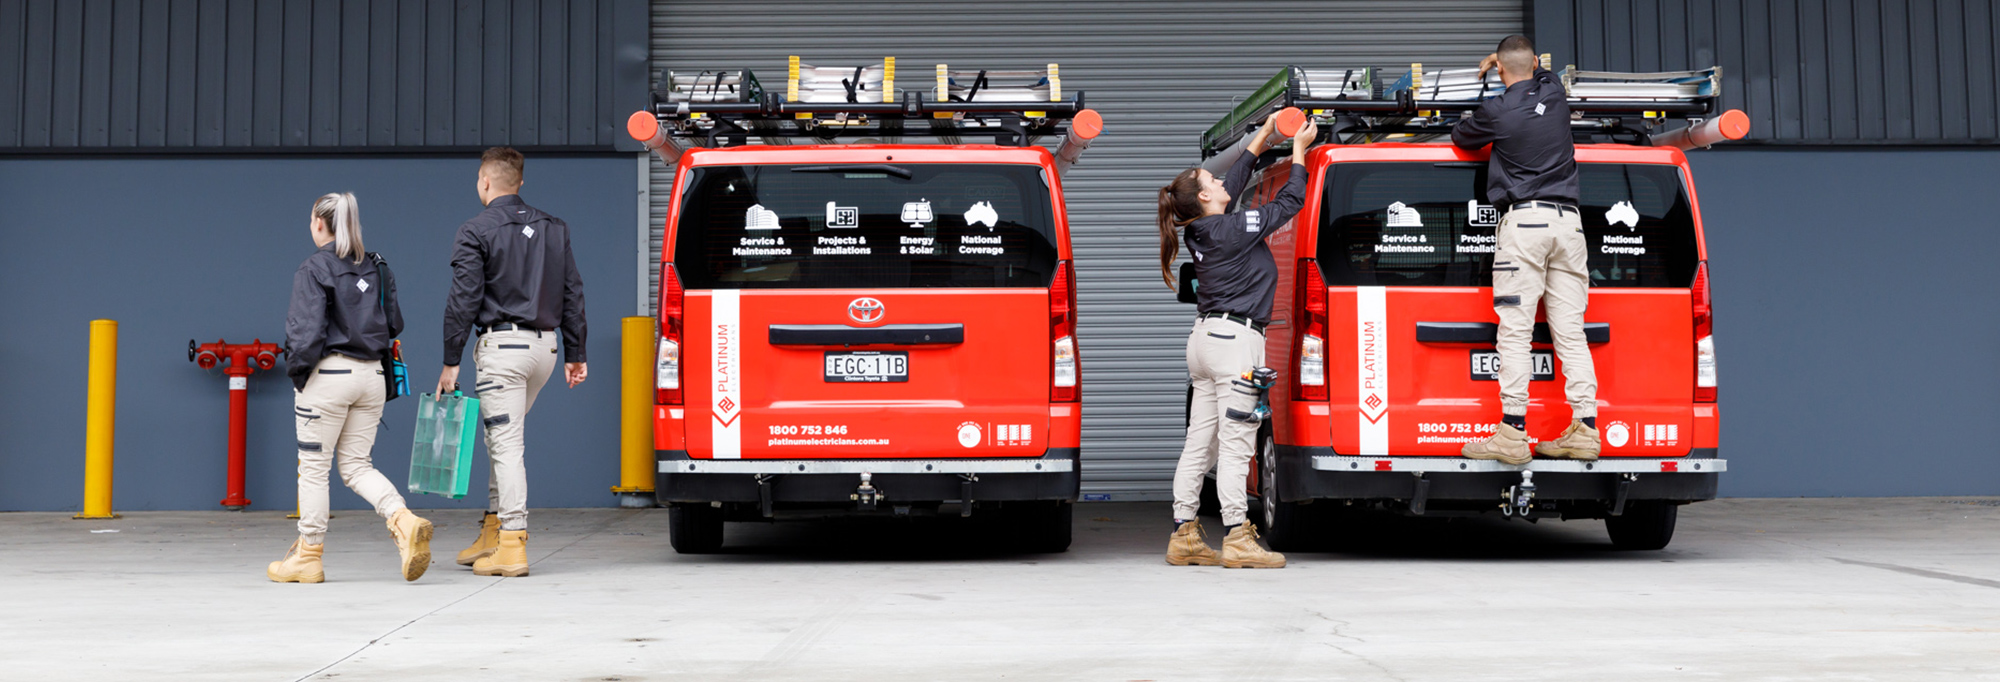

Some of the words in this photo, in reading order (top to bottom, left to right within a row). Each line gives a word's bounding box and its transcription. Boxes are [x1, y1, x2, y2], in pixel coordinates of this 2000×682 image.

[740, 237, 776, 246] Service
[776, 237, 785, 246] &
[817, 236, 858, 247] Projects
[858, 236, 867, 245] &
[899, 236, 935, 246] Energy
[960, 236, 1002, 245] National
[1381, 234, 1418, 243] Service
[1418, 234, 1427, 243] &
[1460, 234, 1496, 244] Project
[1603, 235, 1643, 244] National
[732, 247, 793, 256] Maintenance
[812, 246, 872, 255] Installations
[899, 246, 908, 255] &
[908, 246, 935, 255] Solar
[958, 246, 1004, 256] Coverage
[1374, 244, 1435, 253] Maintenance
[1455, 244, 1495, 253] Installat
[1600, 245, 1646, 256] Coverage
[717, 324, 729, 393] PLATINUM
[1363, 321, 1376, 389] PLATINUM
[768, 425, 798, 435] 1800
[800, 425, 822, 435] 752
[824, 425, 848, 435] 846
[1418, 423, 1448, 433] 1800
[1450, 423, 1472, 433] 752
[768, 438, 890, 447] platinumelectricians.com.au
